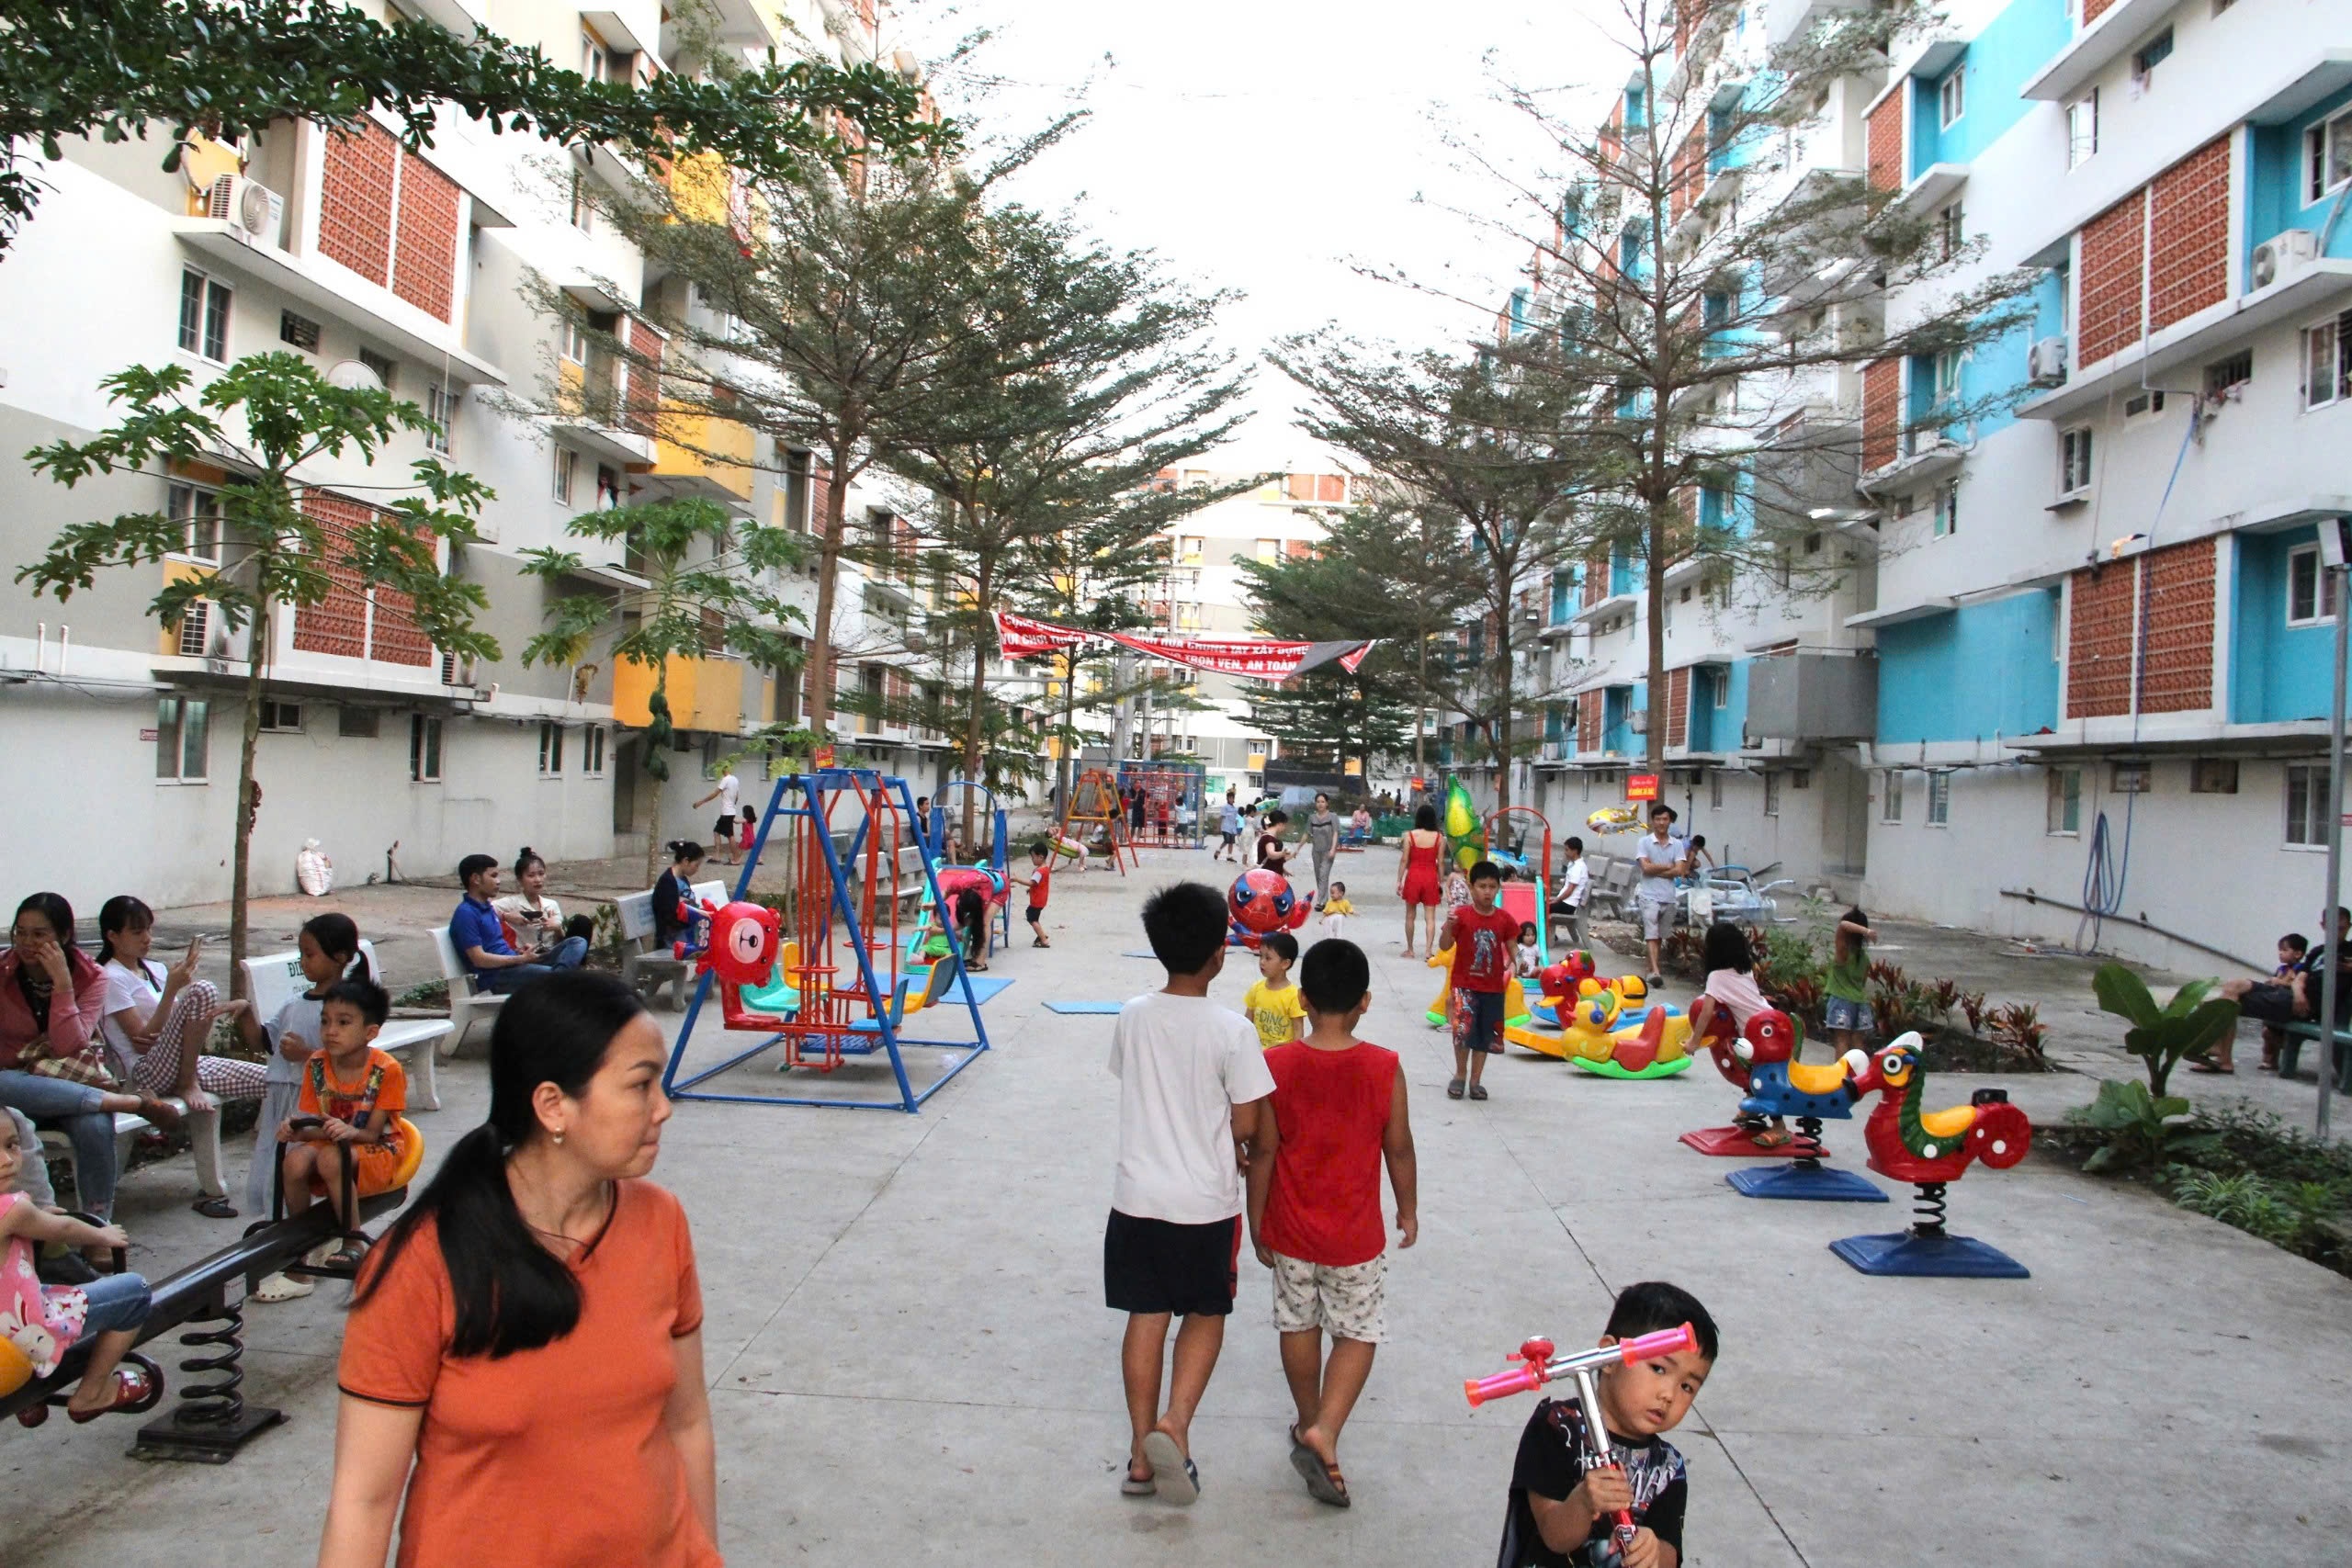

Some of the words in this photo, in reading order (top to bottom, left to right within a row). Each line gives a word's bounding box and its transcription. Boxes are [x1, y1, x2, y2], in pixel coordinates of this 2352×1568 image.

[1187, 640, 1227, 653] CHUNG
[1230, 645, 1250, 655] TAY
[1252, 644, 1274, 655] XÂY
[1247, 660, 1263, 671] AN
[1267, 659, 1297, 671] TOÀN
[1260, 1010, 1294, 1028] DINO
